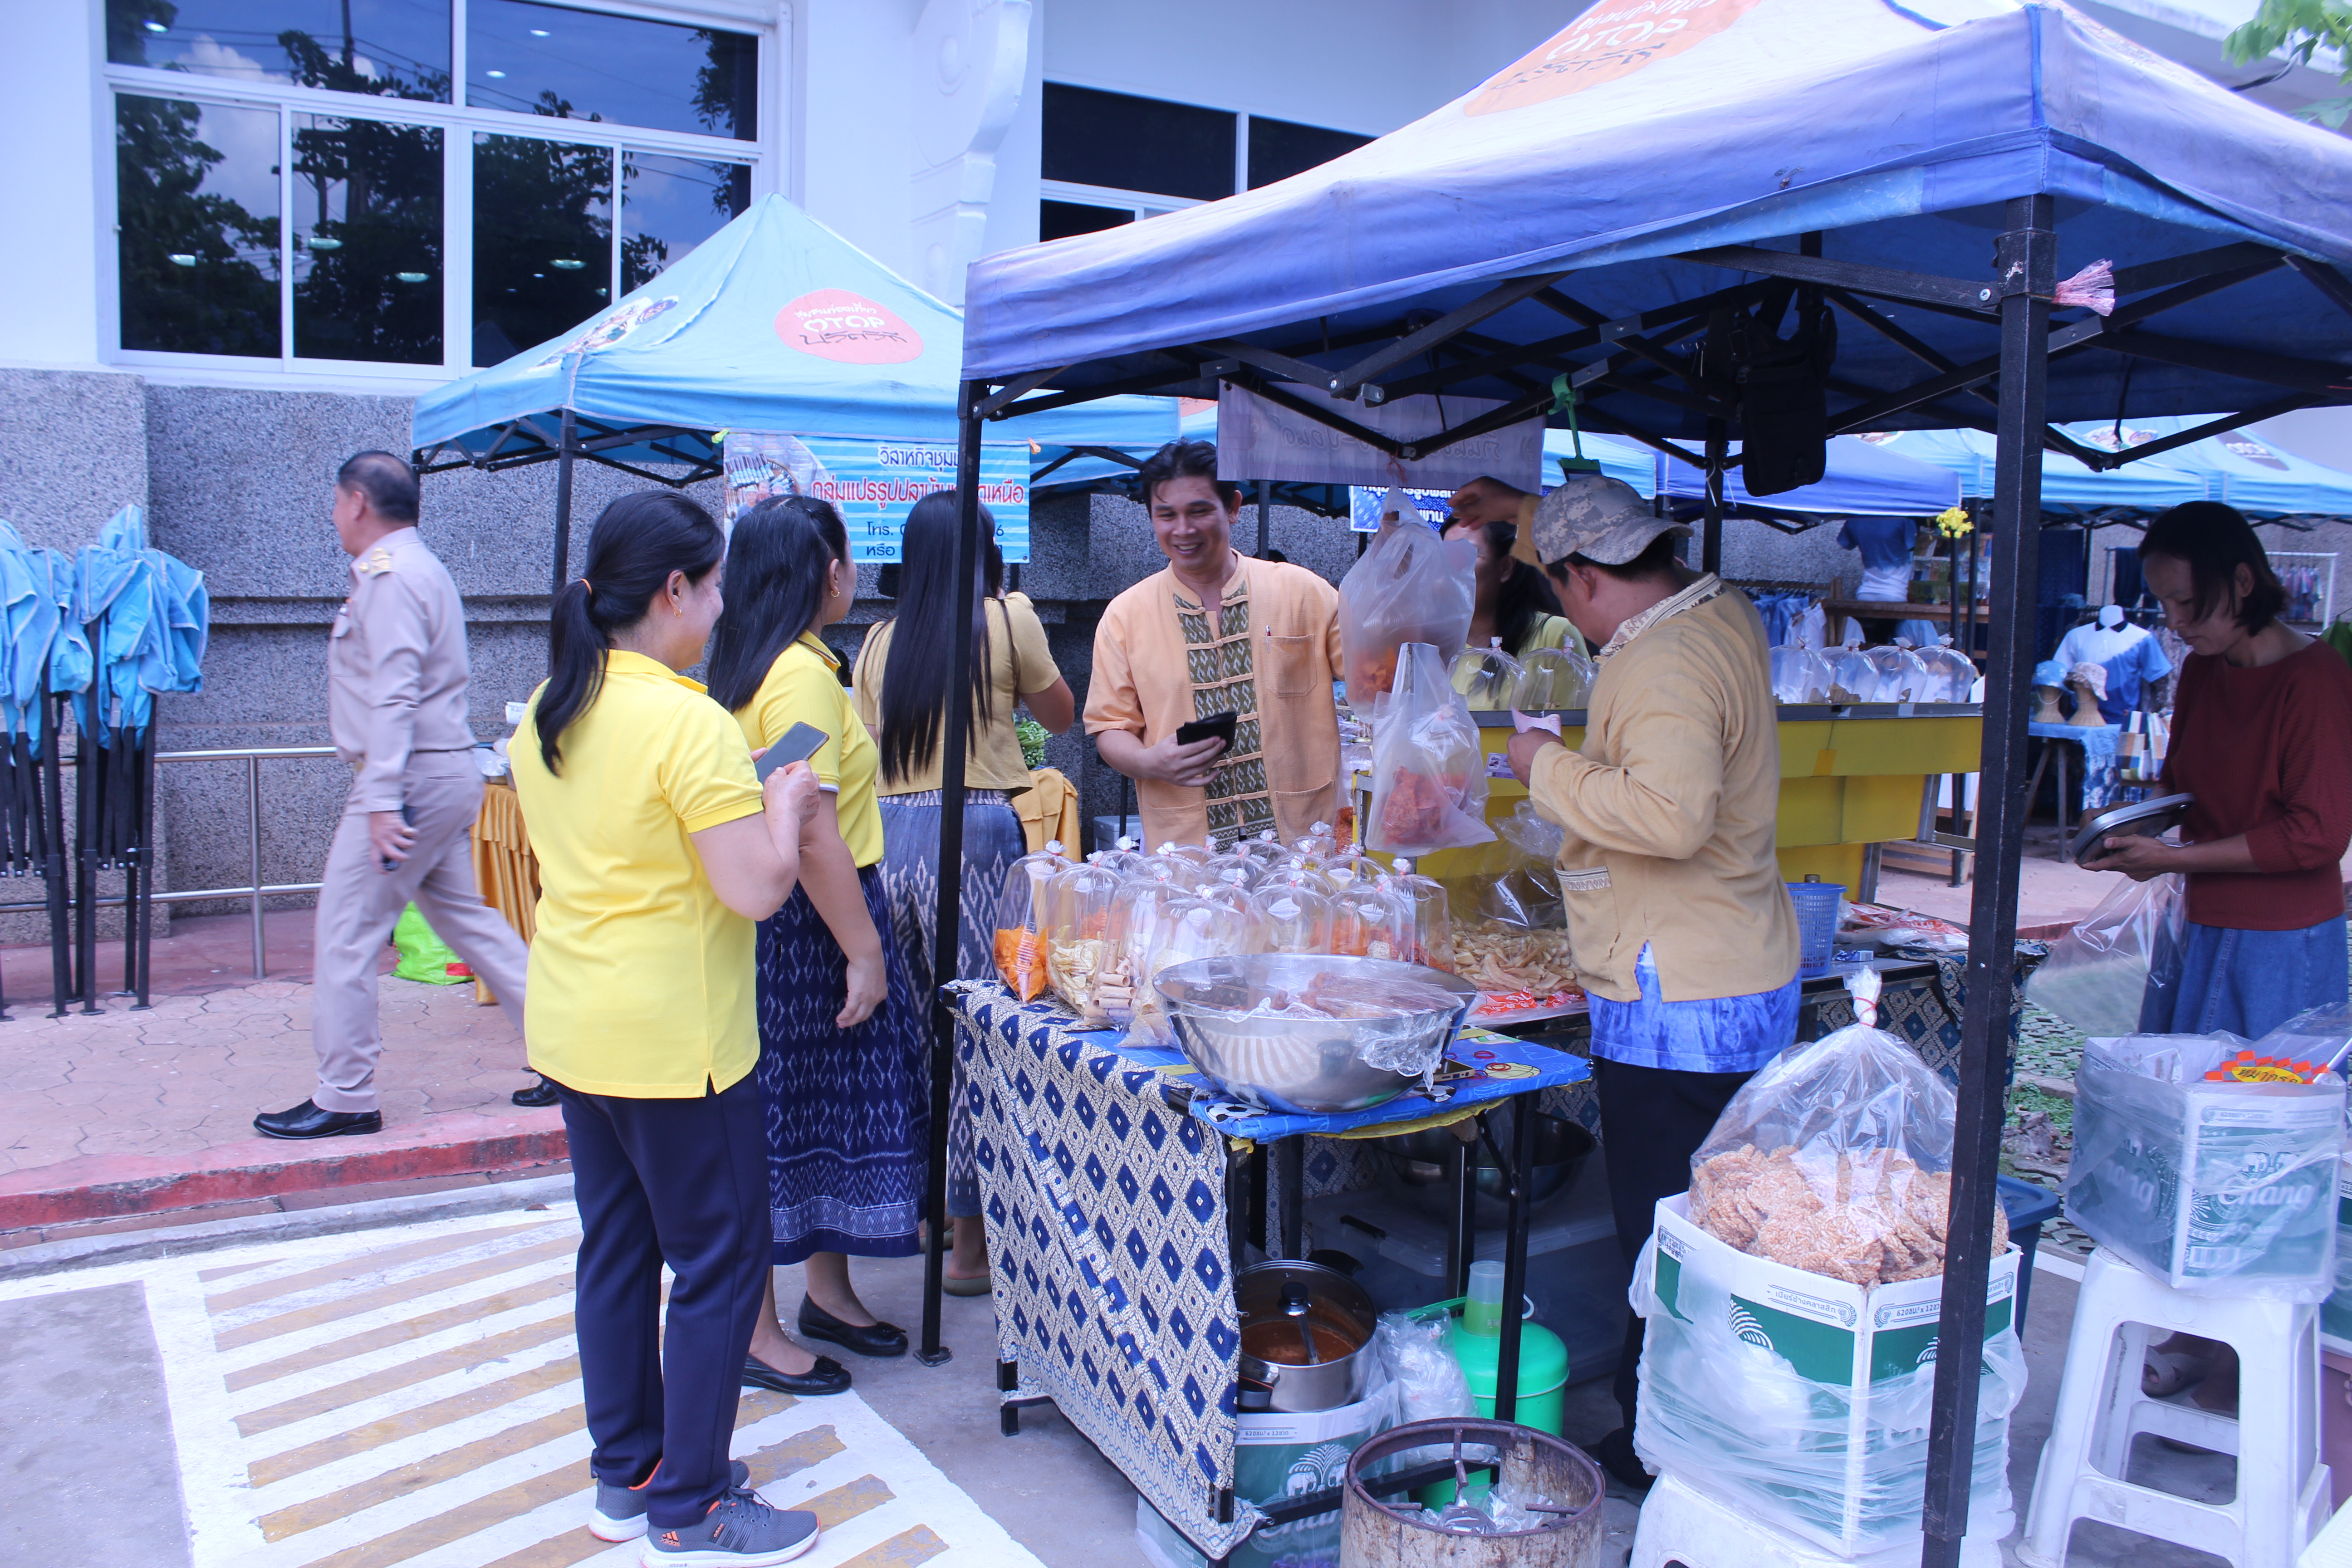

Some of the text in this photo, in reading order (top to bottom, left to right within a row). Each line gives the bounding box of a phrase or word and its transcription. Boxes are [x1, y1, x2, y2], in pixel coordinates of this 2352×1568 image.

[1546, 18, 1688, 60] OTOP
[804, 315, 886, 333] OTOP
[867, 521, 893, 535] โทร.
[867, 543, 895, 556] หรือ
[660, 1537, 681, 1547] adidas
